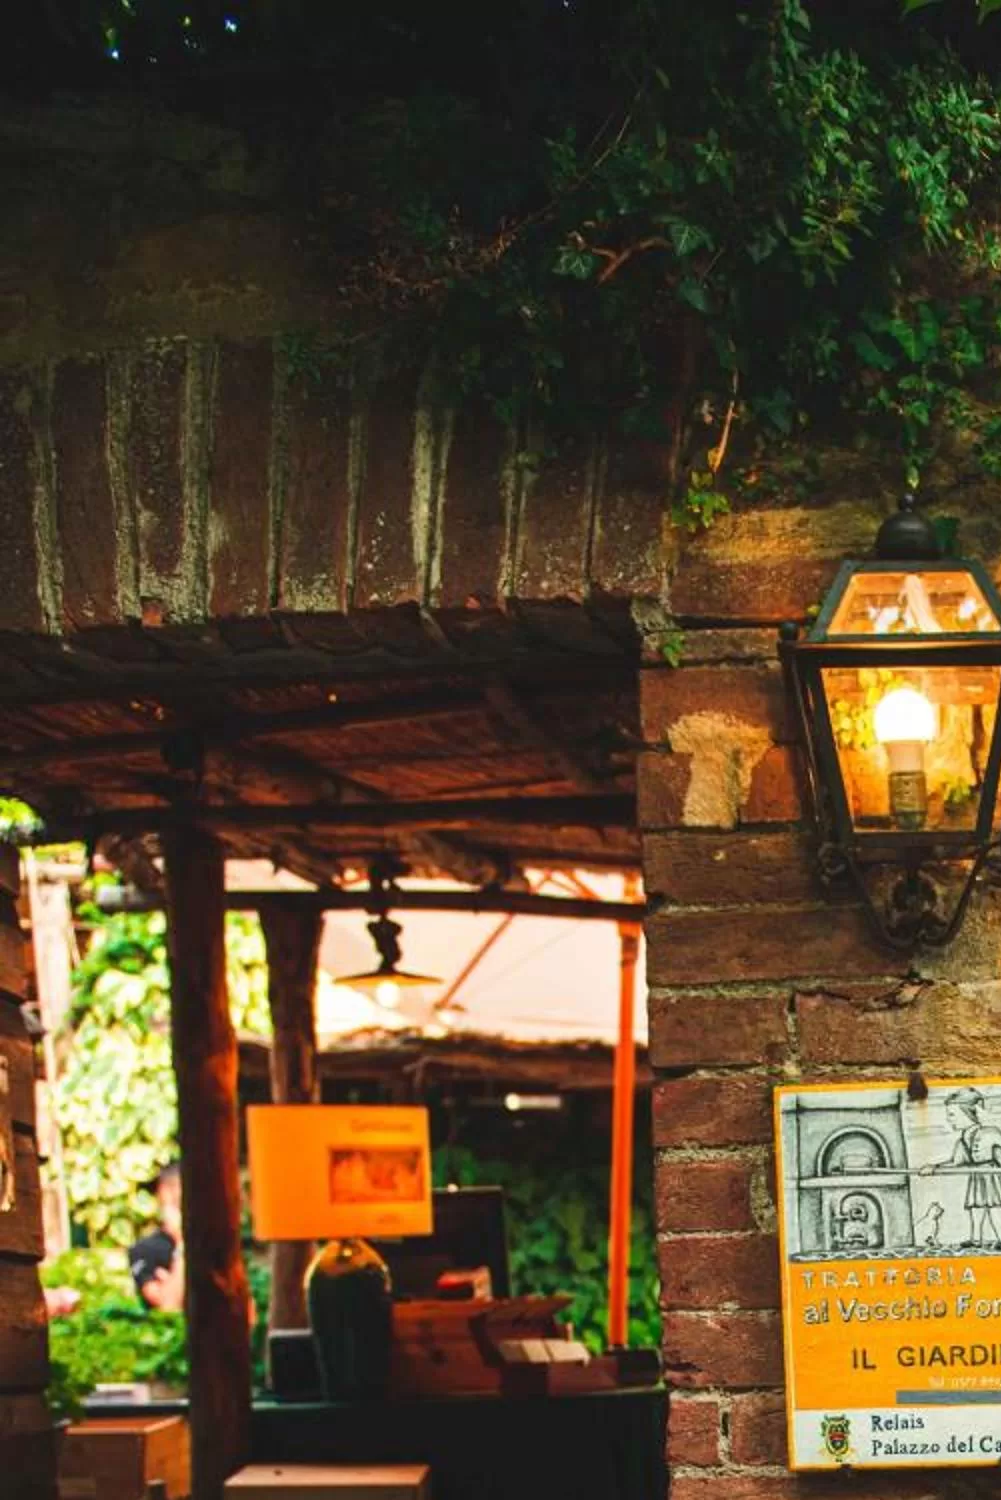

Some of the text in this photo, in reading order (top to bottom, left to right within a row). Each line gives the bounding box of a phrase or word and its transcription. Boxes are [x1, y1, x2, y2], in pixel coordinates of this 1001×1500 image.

[802, 1266, 977, 1289] TRATTORIA
[803, 1298, 830, 1324] al
[836, 1296, 948, 1323] Vecchio
[852, 1347, 877, 1370] IL
[871, 1413, 925, 1432] Relais
[872, 1438, 941, 1457] Palazzo
[946, 1435, 974, 1454] del
